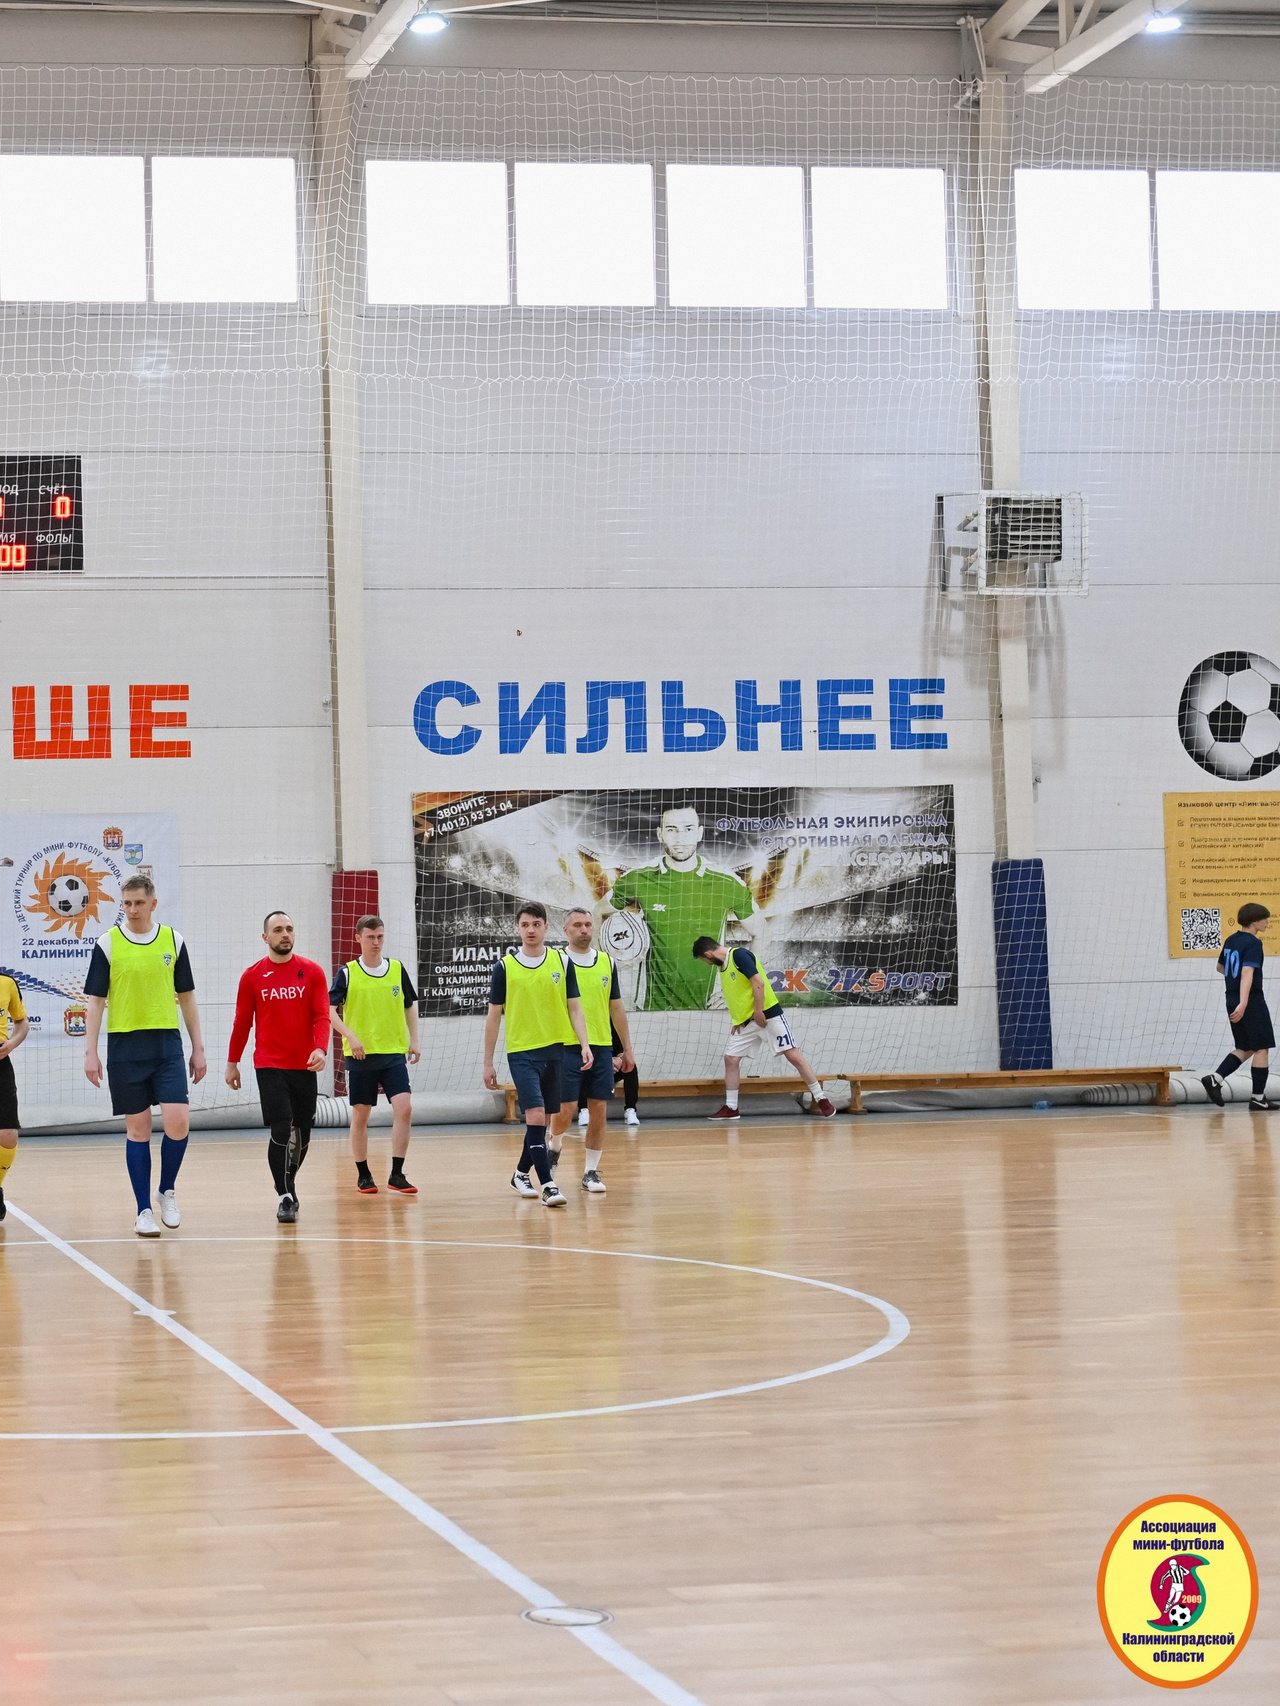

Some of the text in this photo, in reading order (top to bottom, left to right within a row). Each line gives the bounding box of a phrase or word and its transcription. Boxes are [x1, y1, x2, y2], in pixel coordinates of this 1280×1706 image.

[38, 482, 67, 495] СЧЁТ
[55, 495, 71, 518] 0
[35, 533, 72, 544] ФОЛЫ
[412, 678, 948, 756] СИЛЬНЕЕ
[436, 795, 488, 819] ЗВОНИТЕ:
[423, 800, 513, 838] +7 (4012) 93 31 04
[716, 813, 948, 831] ФУТБОЛЬНАЯ ЭКИПИРОВКА
[761, 832, 949, 849] СПОРТИВНАЯ ОДЕЖДА
[32, 851, 43, 862] ПО
[42, 841, 103, 857] МИНИ-ФУТБОЛУ
[837, 850, 949, 866] АКСЕССУАРЫ
[15, 860, 33, 887] ТУРНИР
[13, 890, 26, 926] ДЕТСКИЙ
[22, 937, 100, 947] 22 декабря 20
[613, 930, 630, 942] 2K
[22, 948, 93, 959] КАЛИНИНГ
[452, 946, 501, 962] ИЛАН
[435, 964, 495, 975] ОФИЦИАЛЬН
[1223, 948, 1240, 979] 70
[438, 975, 493, 985] В КАЛИНИН
[869, 972, 951, 992] SPORT
[261, 985, 306, 1002] FARBY
[423, 987, 491, 997] Г. КАЛИНИНГРА
[776, 1034, 790, 1047] 21
